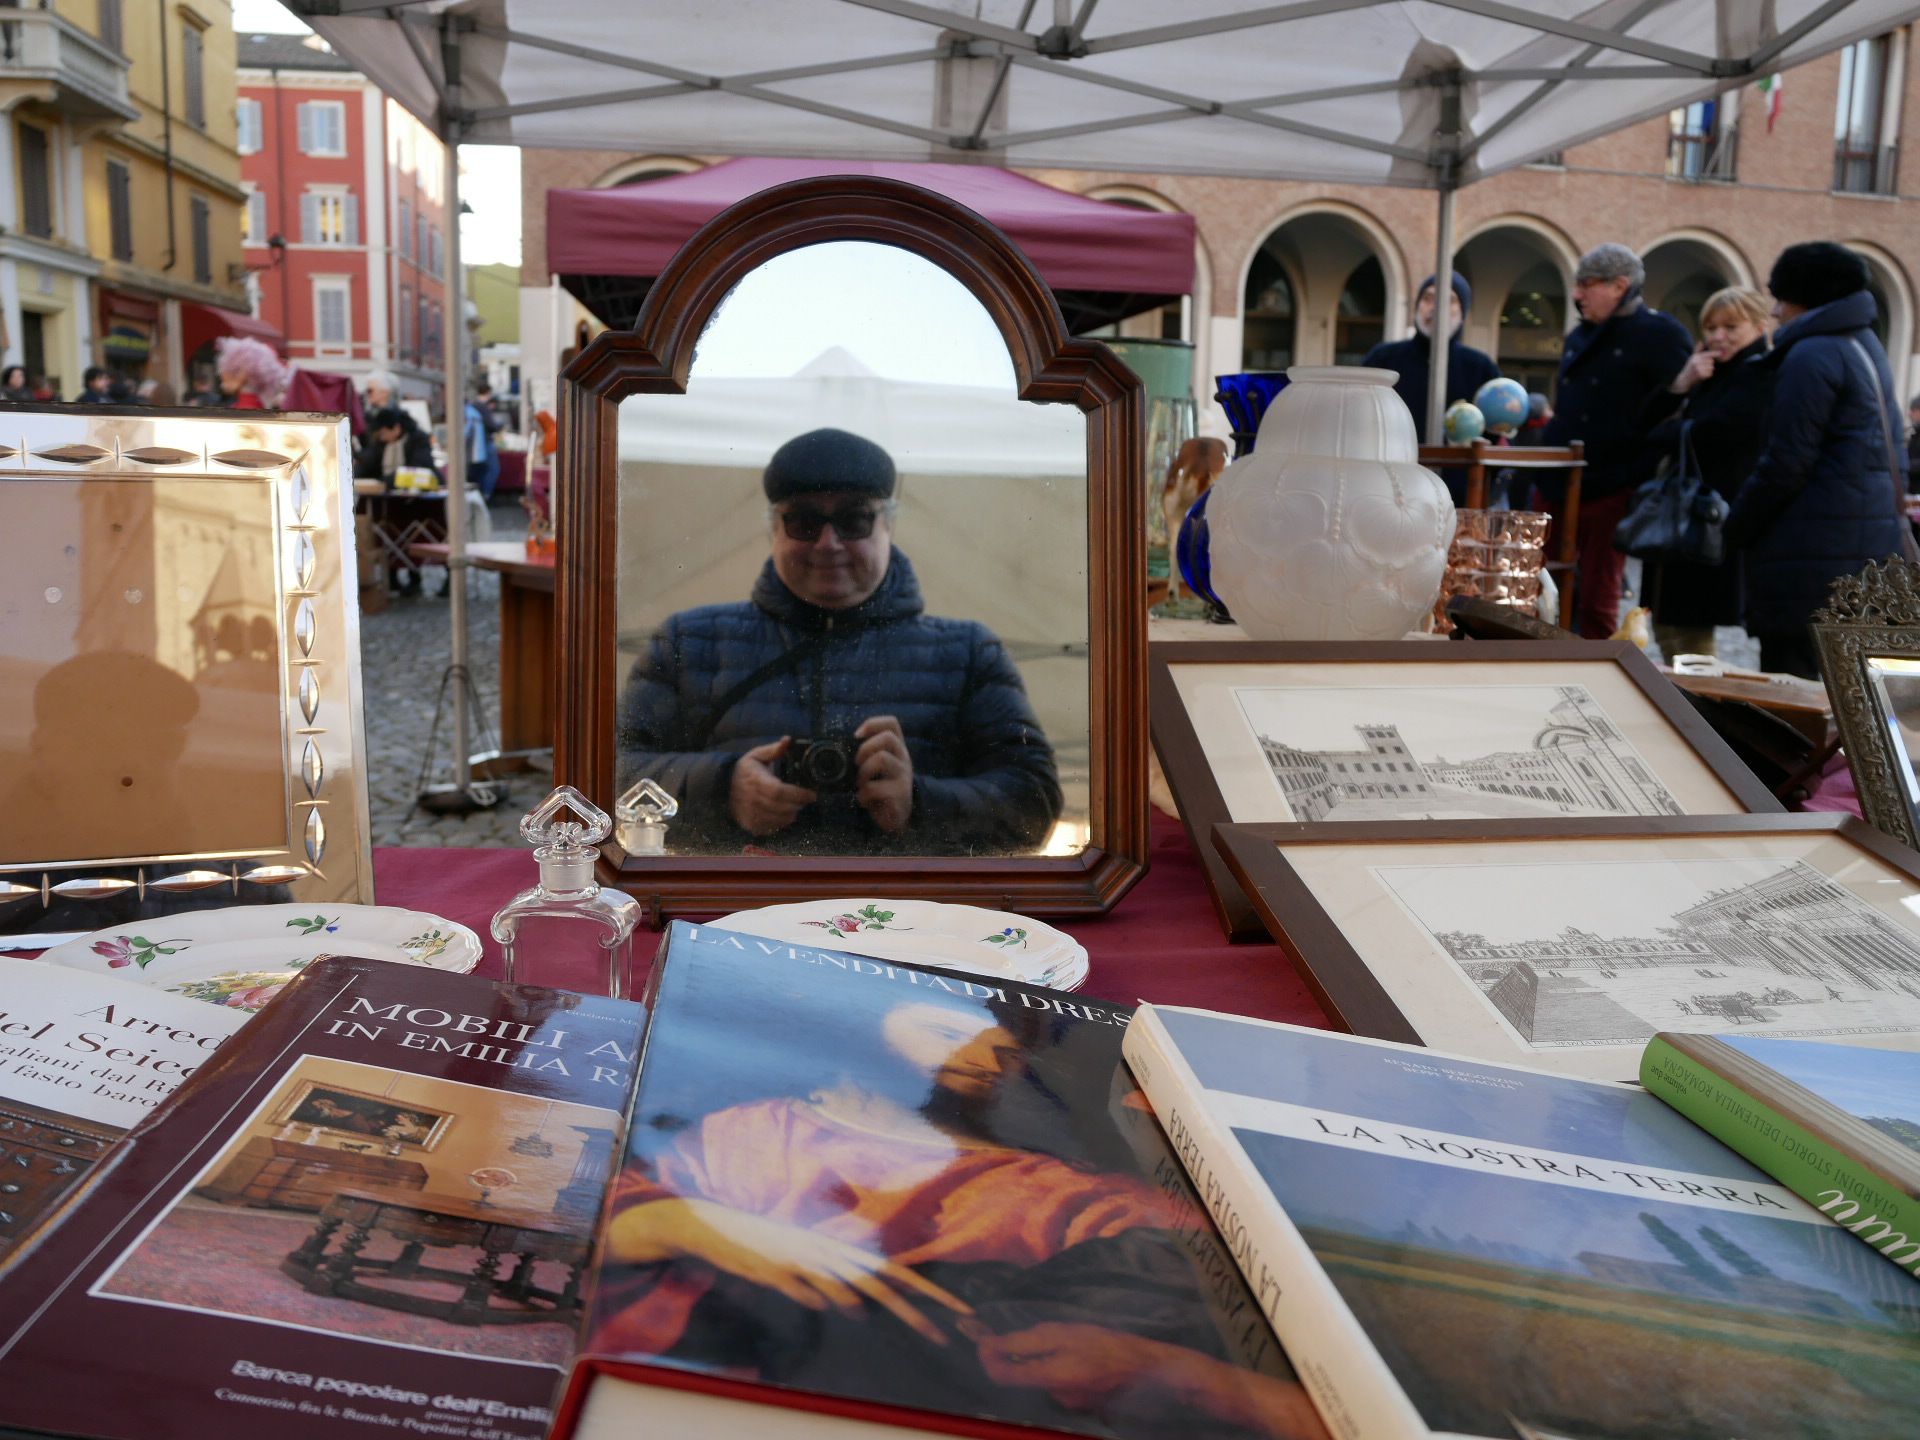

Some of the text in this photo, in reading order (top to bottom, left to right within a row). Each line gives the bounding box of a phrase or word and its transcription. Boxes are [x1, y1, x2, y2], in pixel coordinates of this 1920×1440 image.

[689, 928, 745, 950] LA
[756, 941, 953, 992] VENDITA
[960, 980, 1011, 1004] DI
[324, 1019, 387, 1042] IN
[397, 1031, 572, 1077] EMILIA
[343, 996, 569, 1050] MOBILI
[0, 1043, 85, 1071] aliani
[90, 1067, 137, 1085] dal
[12, 1064, 158, 1108] fasto baro
[1663, 1057, 1713, 1098] ROMAGNA
[1310, 1118, 1793, 1212] LA NOSTRA TERRA
[1783, 1134, 1833, 1177] STORICI
[1169, 1108, 1283, 1322] LA NOSTRA TERRA
[1834, 1168, 1899, 1219] GIARDINI
[231, 1359, 313, 1388] Banca
[313, 1376, 429, 1406] popolare
